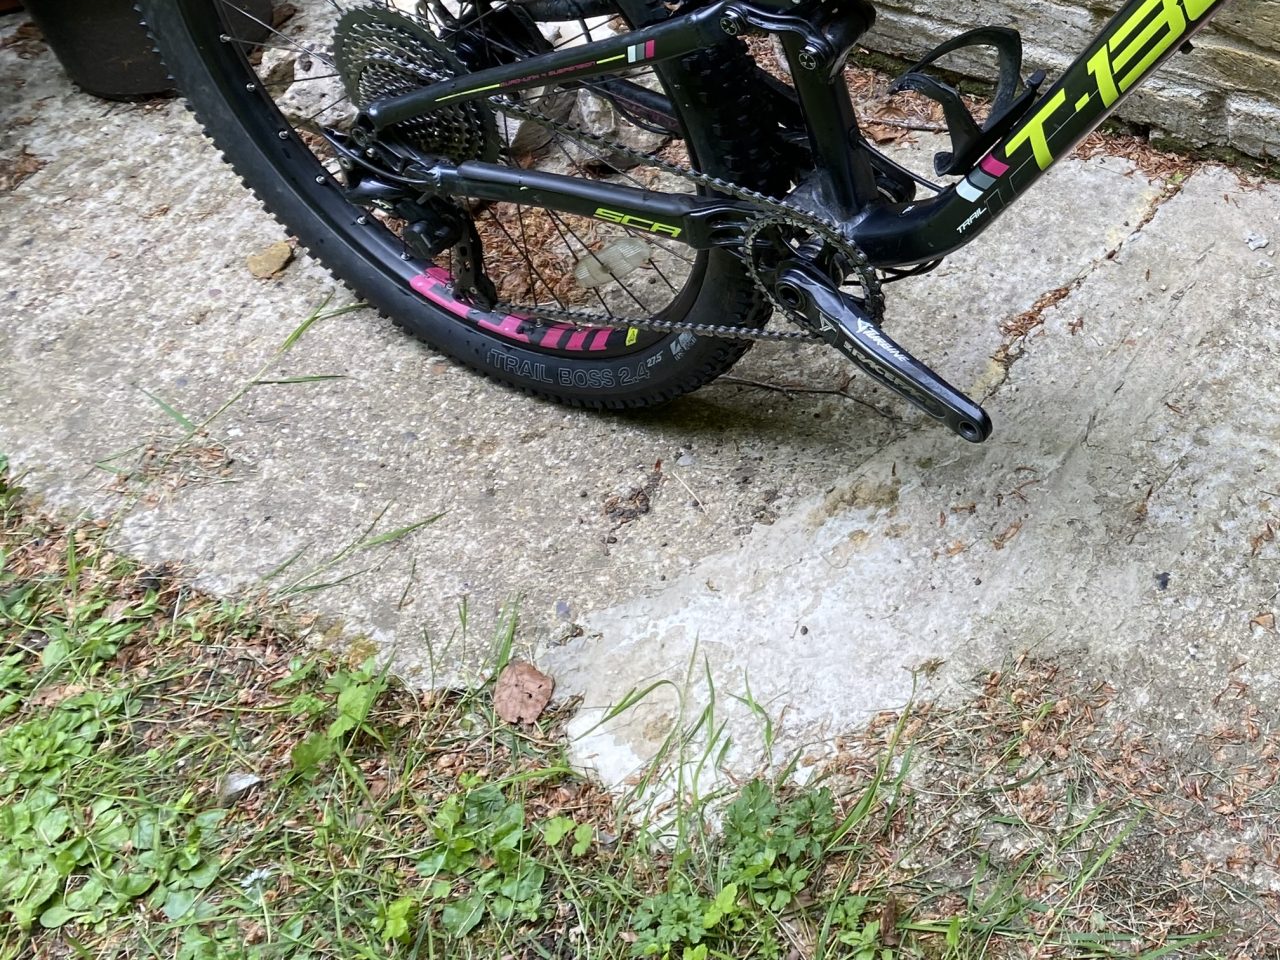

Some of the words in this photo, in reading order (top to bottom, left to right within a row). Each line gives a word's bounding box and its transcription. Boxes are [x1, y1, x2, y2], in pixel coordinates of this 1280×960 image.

[956, 207, 987, 234] TRAIL
[862, 327, 910, 363] TURBINE
[489, 348, 554, 385] TRAIL
[558, 367, 617, 389] BOSS
[618, 362, 651, 387] 2.4
